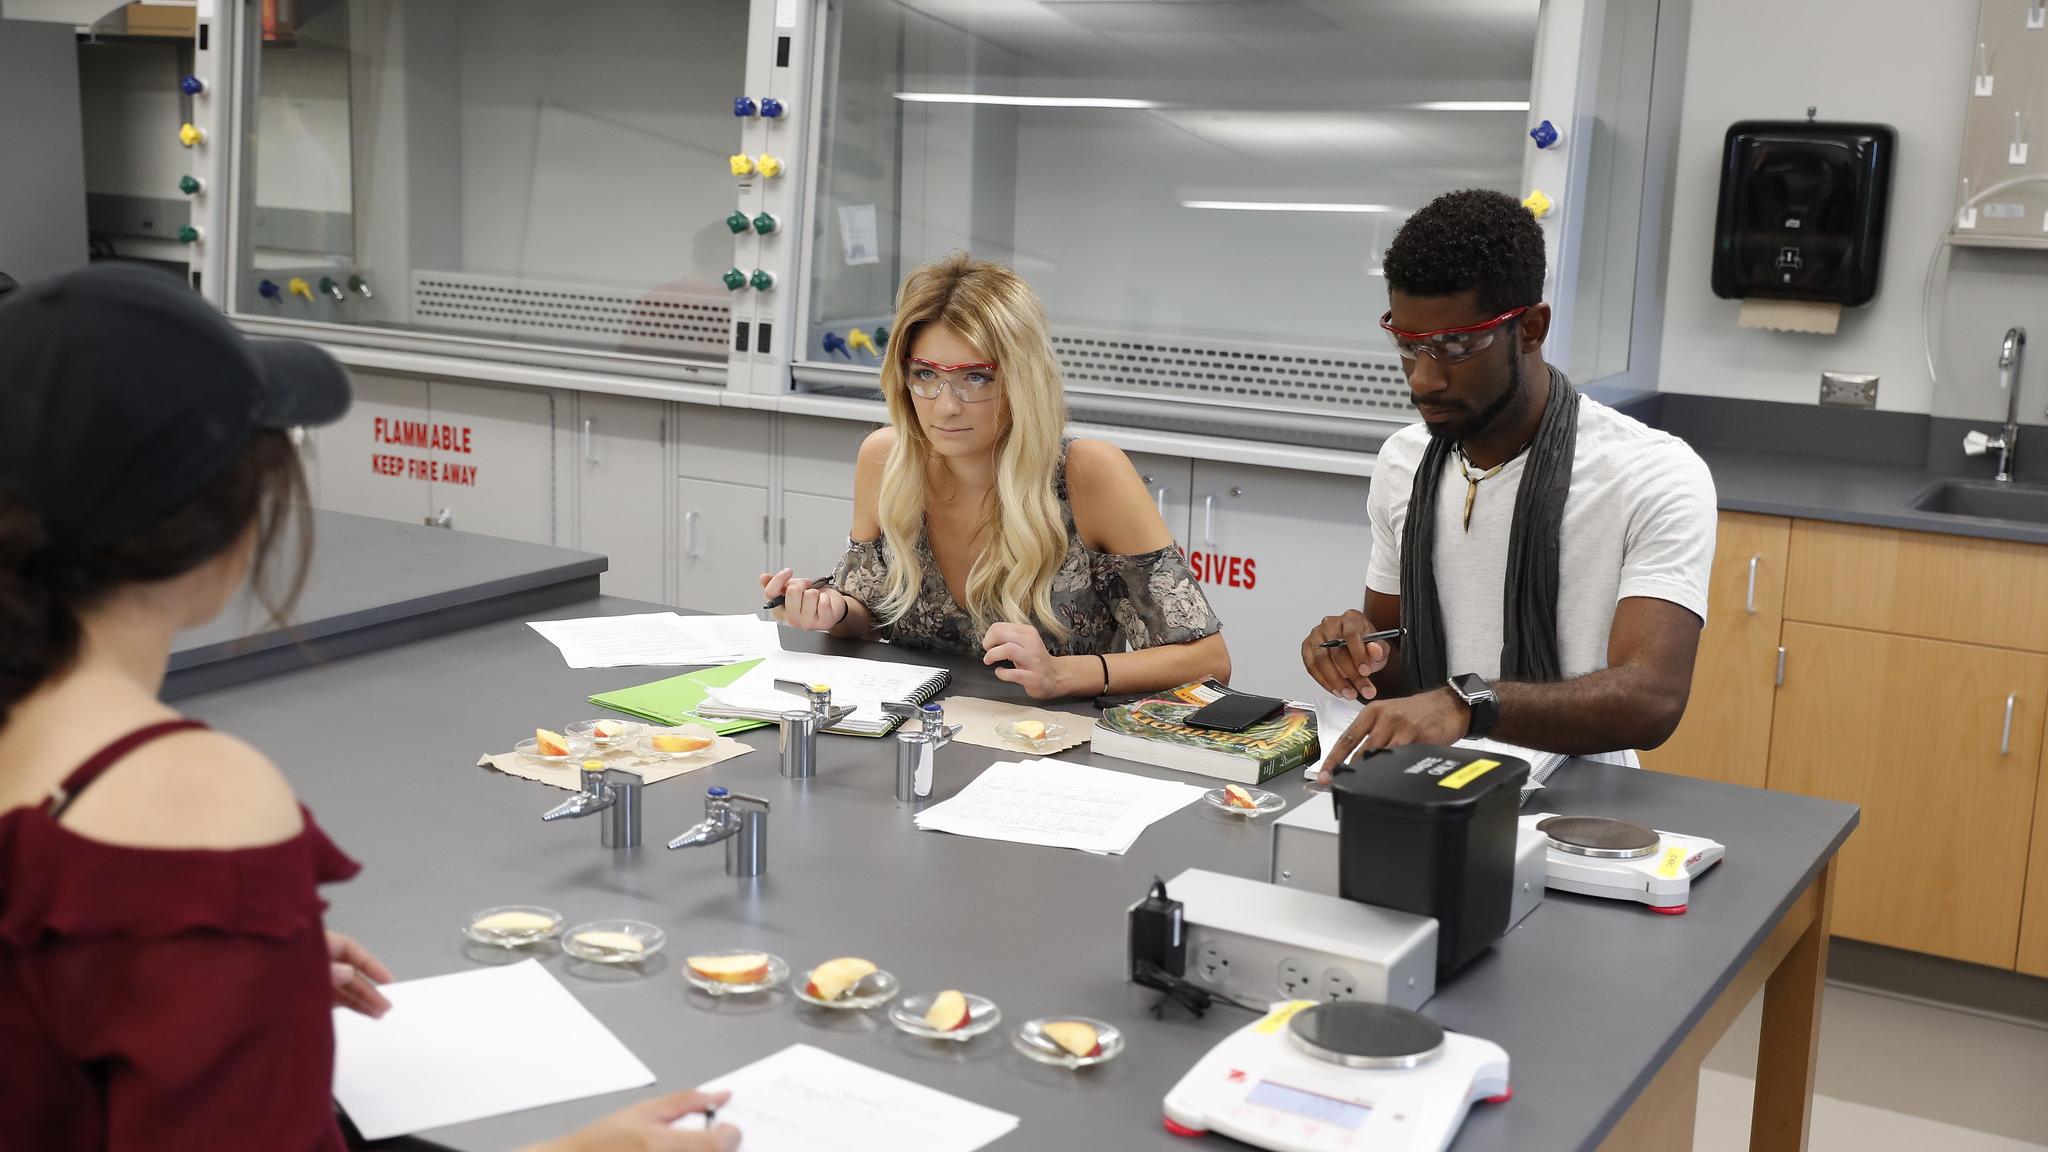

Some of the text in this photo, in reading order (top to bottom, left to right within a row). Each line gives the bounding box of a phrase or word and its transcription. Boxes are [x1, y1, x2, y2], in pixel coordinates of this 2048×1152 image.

[373, 417, 472, 453] FLAMMABLE
[372, 453, 477, 487] KEEP FIRE AWAY
[1179, 547, 1256, 590] SIVES
